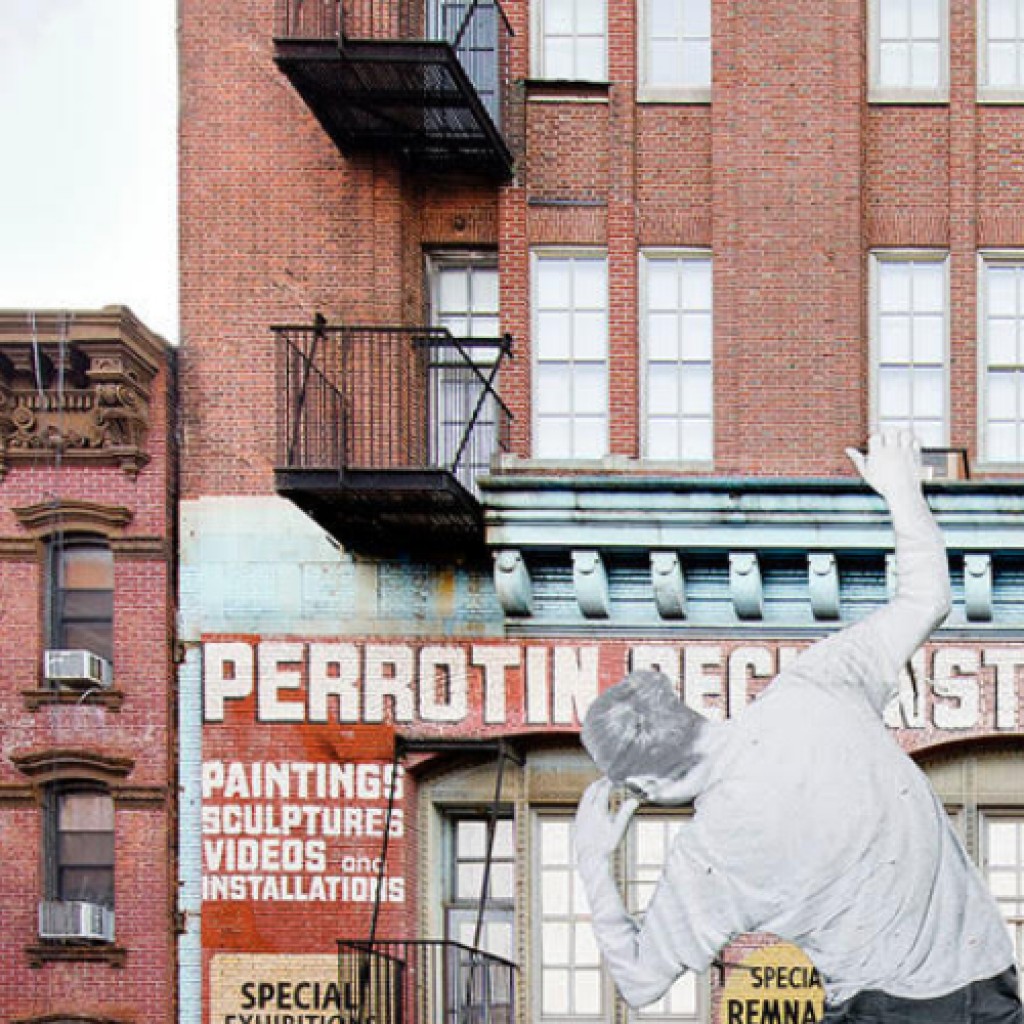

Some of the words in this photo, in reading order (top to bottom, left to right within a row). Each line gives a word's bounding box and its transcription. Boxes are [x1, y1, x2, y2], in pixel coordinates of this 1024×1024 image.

[202, 640, 599, 724] PERROTIN
[202, 760, 405, 800] PAINTINGS
[202, 804, 405, 837] SCULPTURES
[203, 838, 327, 872] VIDEOS
[202, 875, 405, 901] INSTALLATIONS
[750, 966, 821, 989] SPECIA
[240, 981, 359, 1010] SPECIAL
